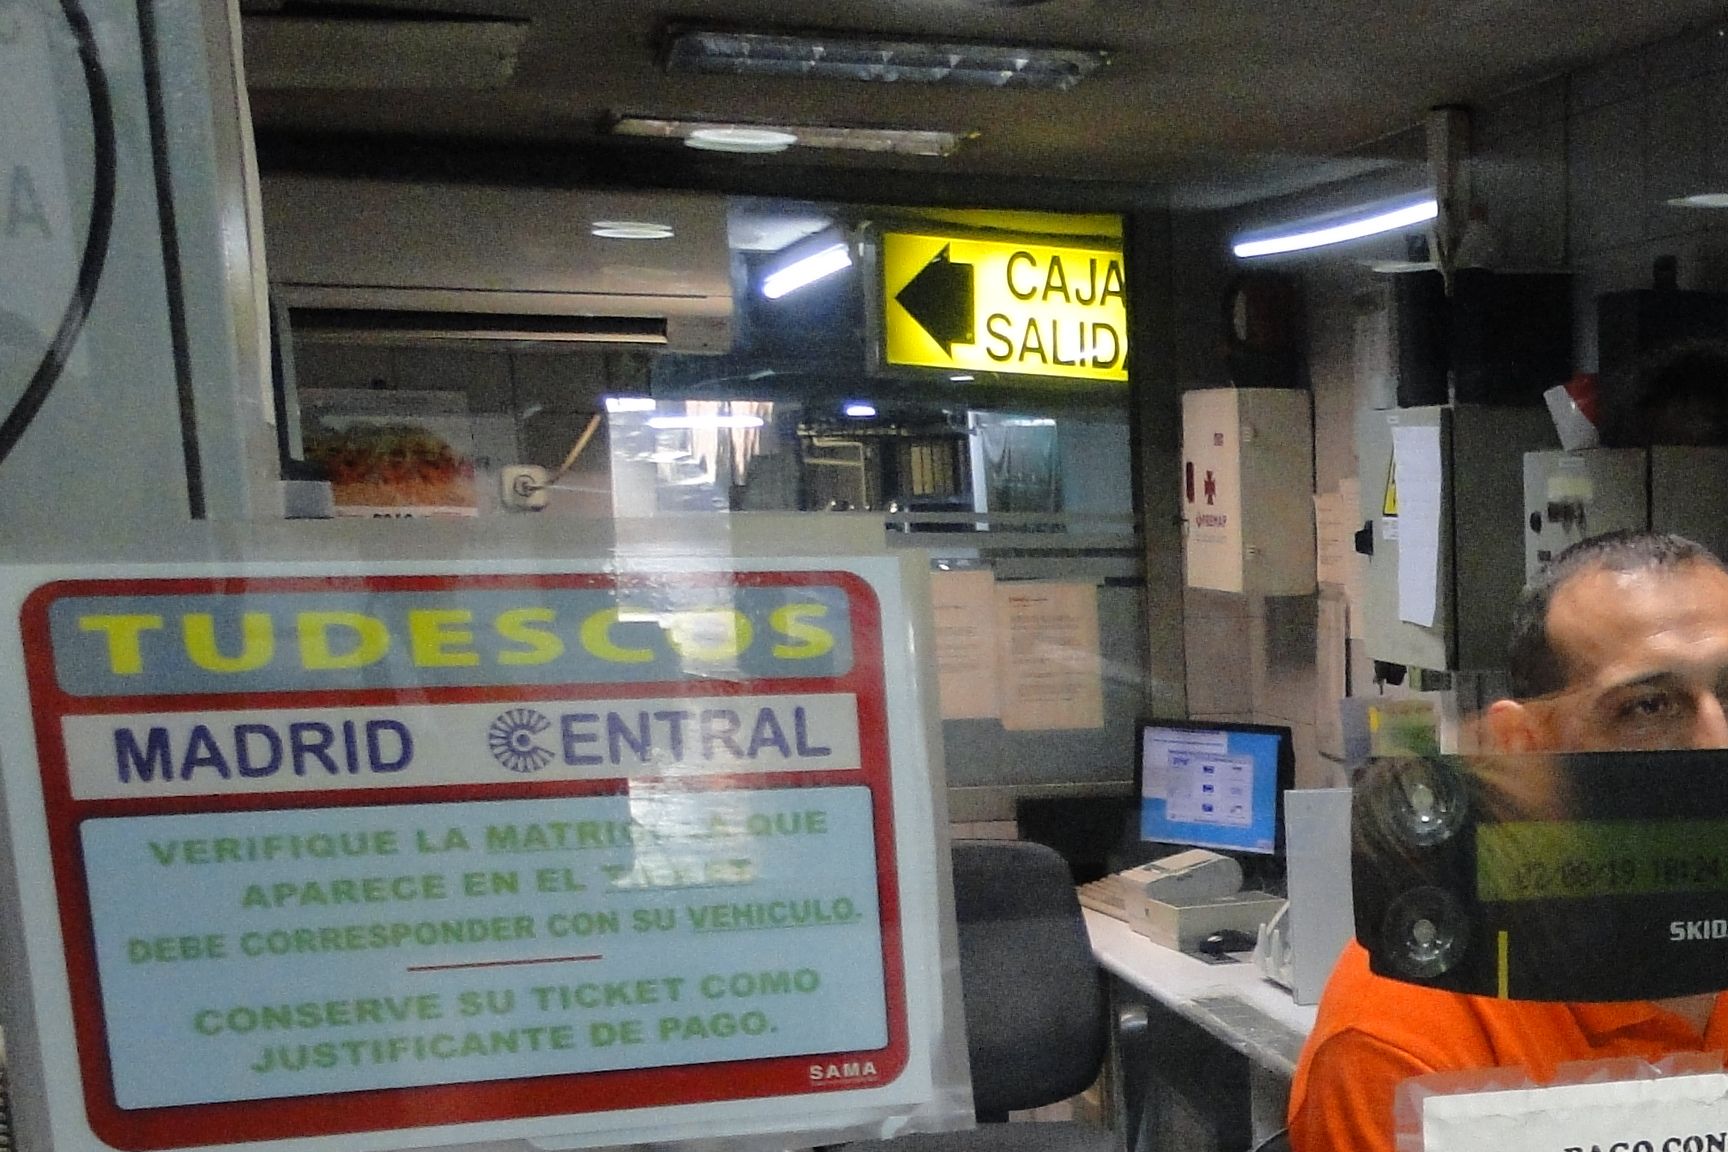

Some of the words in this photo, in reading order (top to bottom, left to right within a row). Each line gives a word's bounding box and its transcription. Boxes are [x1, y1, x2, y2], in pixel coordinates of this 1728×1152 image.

[1006, 251, 1126, 307] CAJA
[986, 313, 1128, 370] SALID
[79, 603, 834, 675] TUDESCOS
[114, 719, 414, 783] MADRID
[150, 829, 398, 866] VERIFIQUE
[416, 826, 469, 854] LA
[747, 810, 827, 837] QUE
[243, 874, 446, 908] APARECE
[463, 870, 519, 897] EN
[536, 868, 588, 892] EL
[128, 934, 226, 964] DEBE
[239, 915, 536, 957] CORRESPONDER
[548, 911, 619, 937] CON
[632, 908, 676, 932] SU
[687, 897, 862, 928] VEHICULO.
[194, 993, 442, 1036] CONSERVE
[457, 989, 514, 1016] SU
[530, 976, 684, 1012] TICKET
[700, 968, 821, 999] COMO
[251, 1026, 574, 1073] JUSTIFICANTE
[589, 1020, 644, 1047] DE
[658, 1010, 778, 1041] PAGO.
[810, 1061, 877, 1080] SAMA
